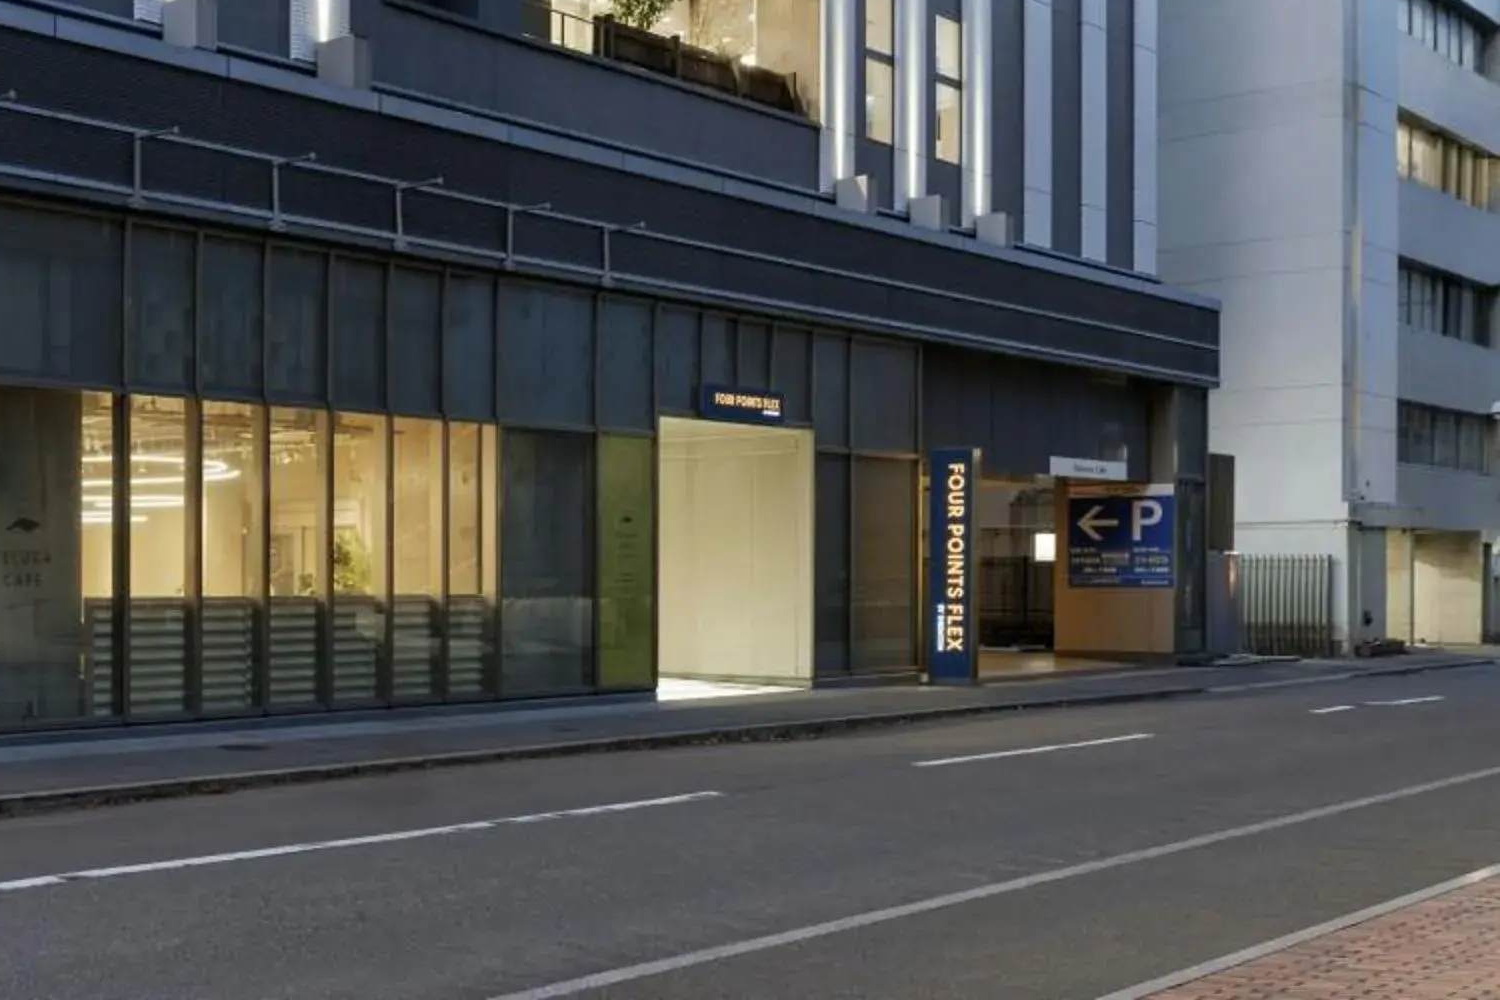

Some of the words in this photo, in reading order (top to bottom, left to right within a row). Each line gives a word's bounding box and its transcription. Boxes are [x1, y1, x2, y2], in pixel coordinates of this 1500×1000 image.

[947, 463, 965, 517] FOUR
[1132, 500, 1163, 541] P
[947, 525, 965, 599] POINTS
[947, 605, 964, 651] FLEX
